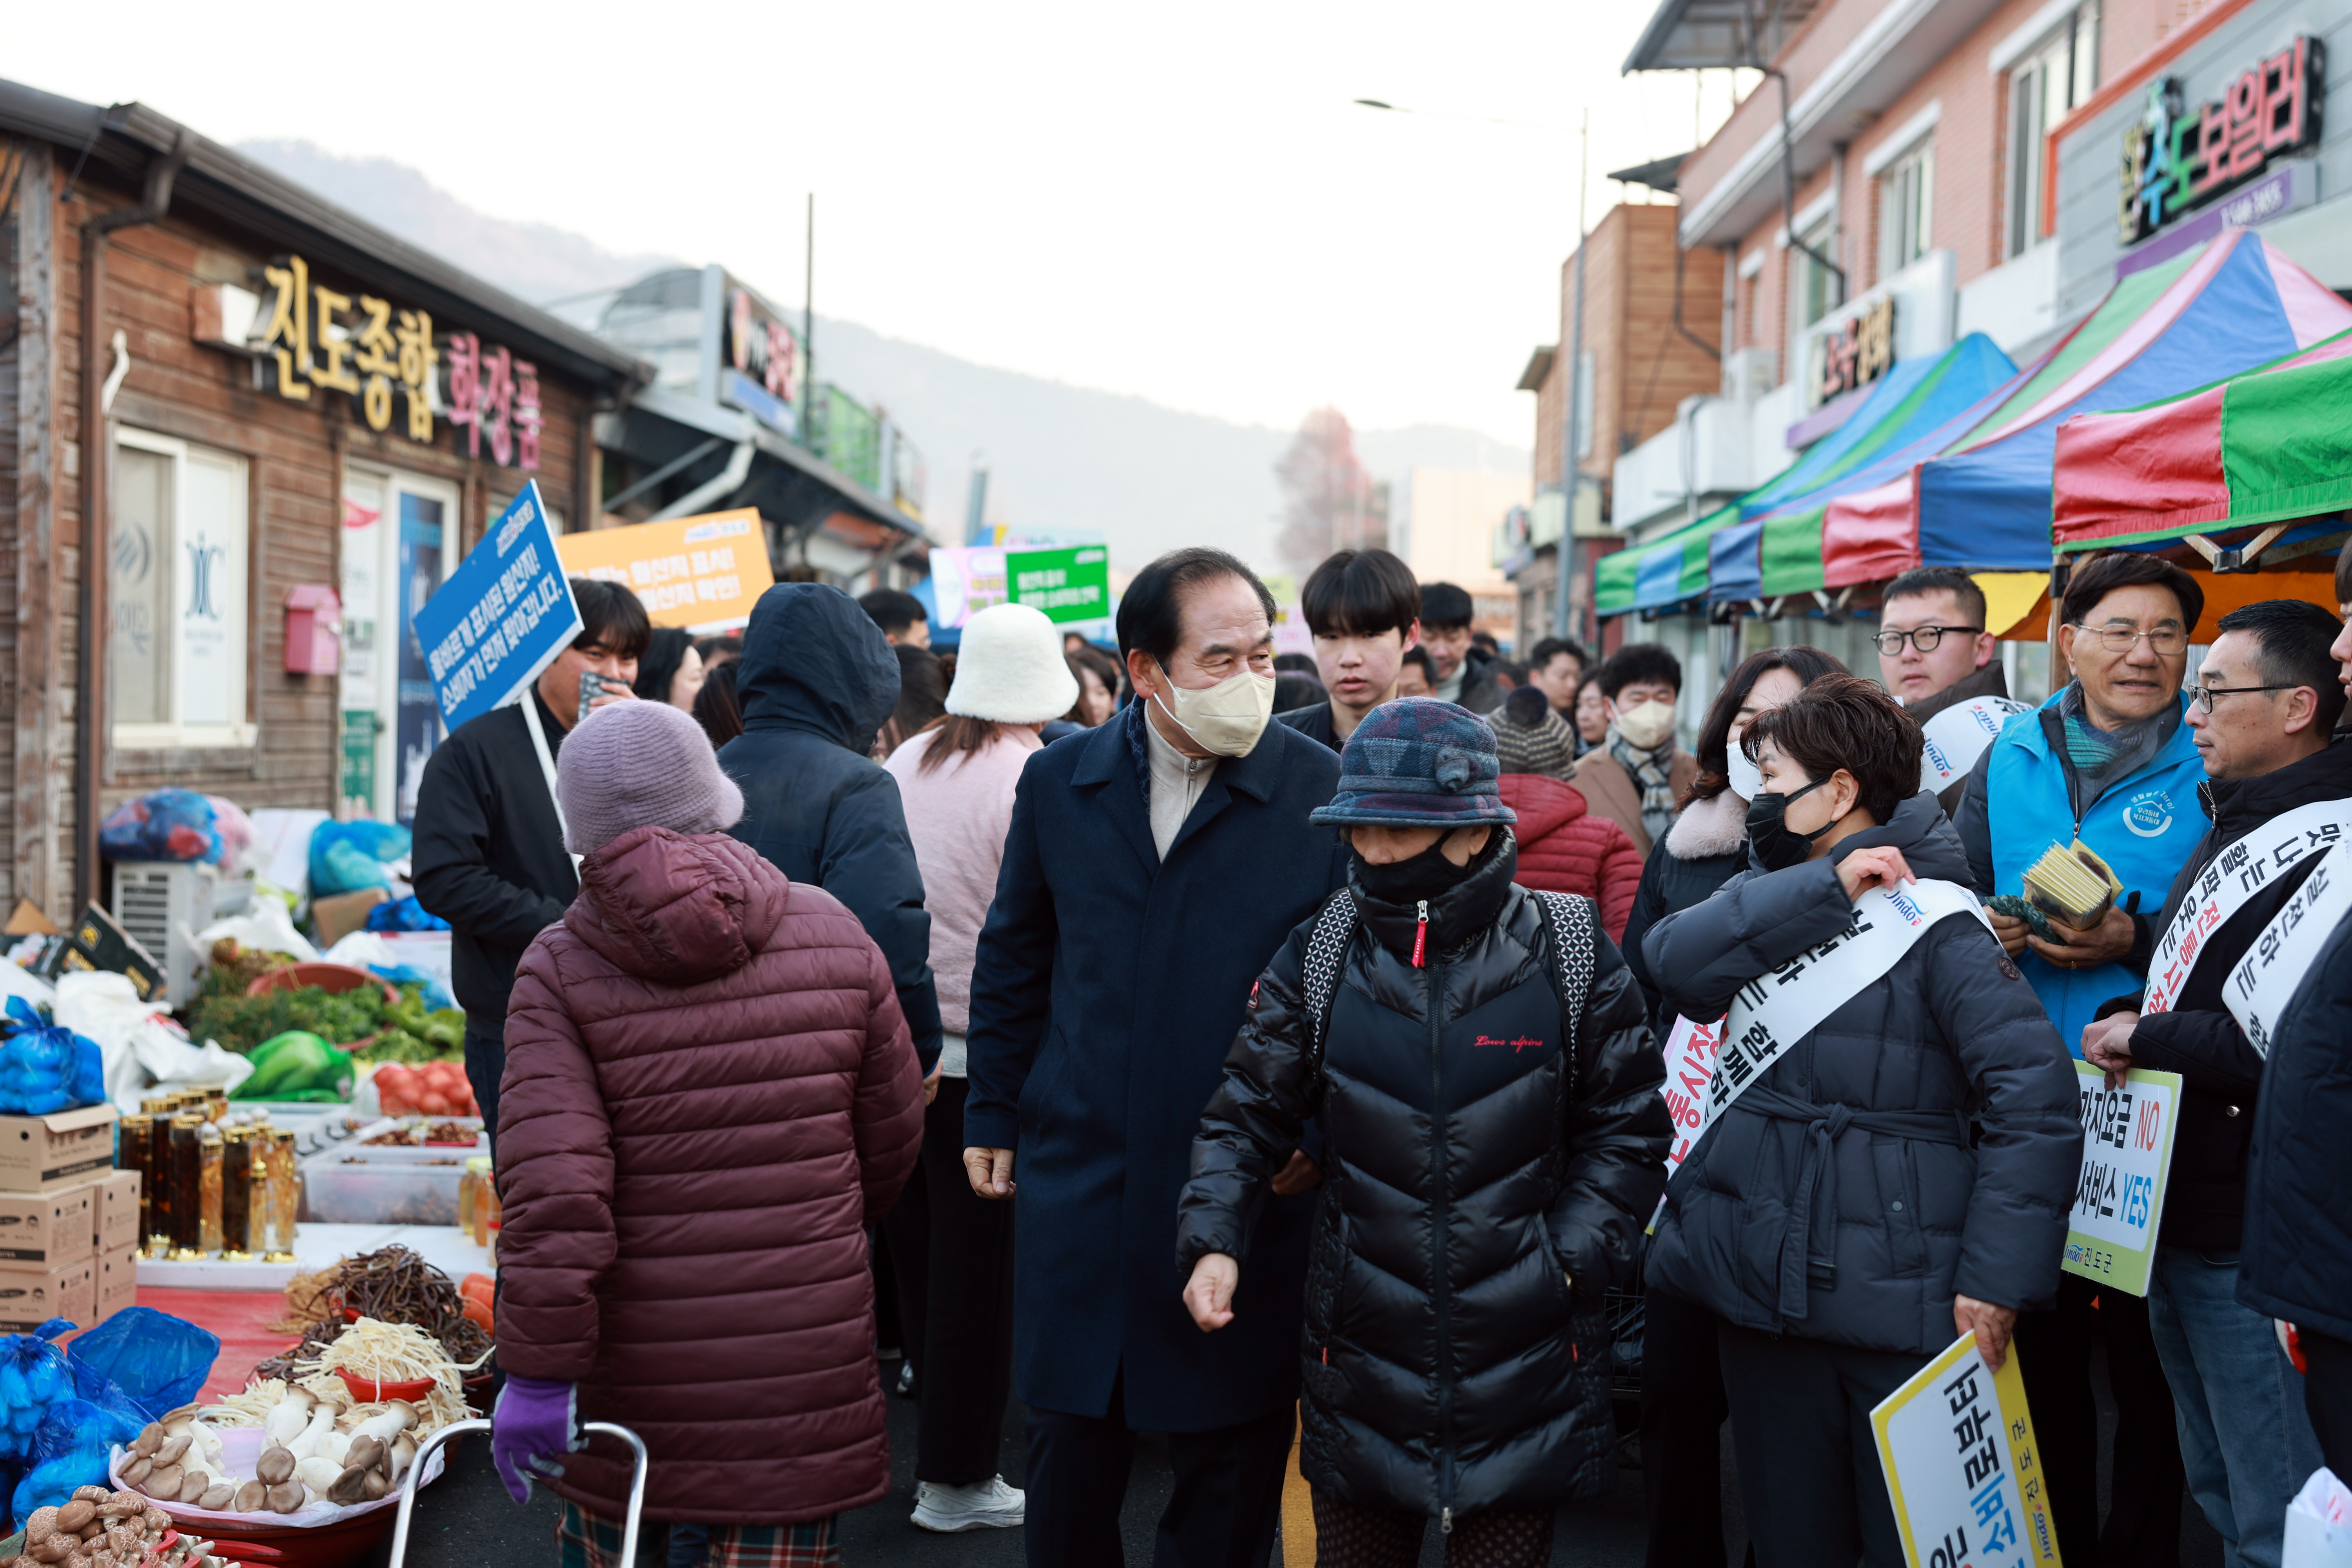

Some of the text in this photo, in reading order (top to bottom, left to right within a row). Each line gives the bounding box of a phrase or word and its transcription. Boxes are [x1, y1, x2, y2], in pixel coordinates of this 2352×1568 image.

[263, 255, 438, 443] 진도종합
[448, 332, 546, 470] 화장품
[630, 553, 691, 585] 원산지
[691, 546, 736, 575] 표시!
[429, 542, 541, 682] 올바르게 표시된 원산지!
[441, 657, 487, 716] 소비자가
[480, 629, 508, 674] 먼저
[2138, 807, 2159, 818] 우리동네
[1882, 889, 1916, 922] Jindo
[2236, 866, 2330, 1002] 실천하는
[1703, 1020, 1780, 1124] 함께하
[2078, 1087, 2159, 1151] 가지요금 NO
[2070, 1160, 2151, 1229] 서비스 YES
[1943, 1361, 2017, 1555] 소비로부터
